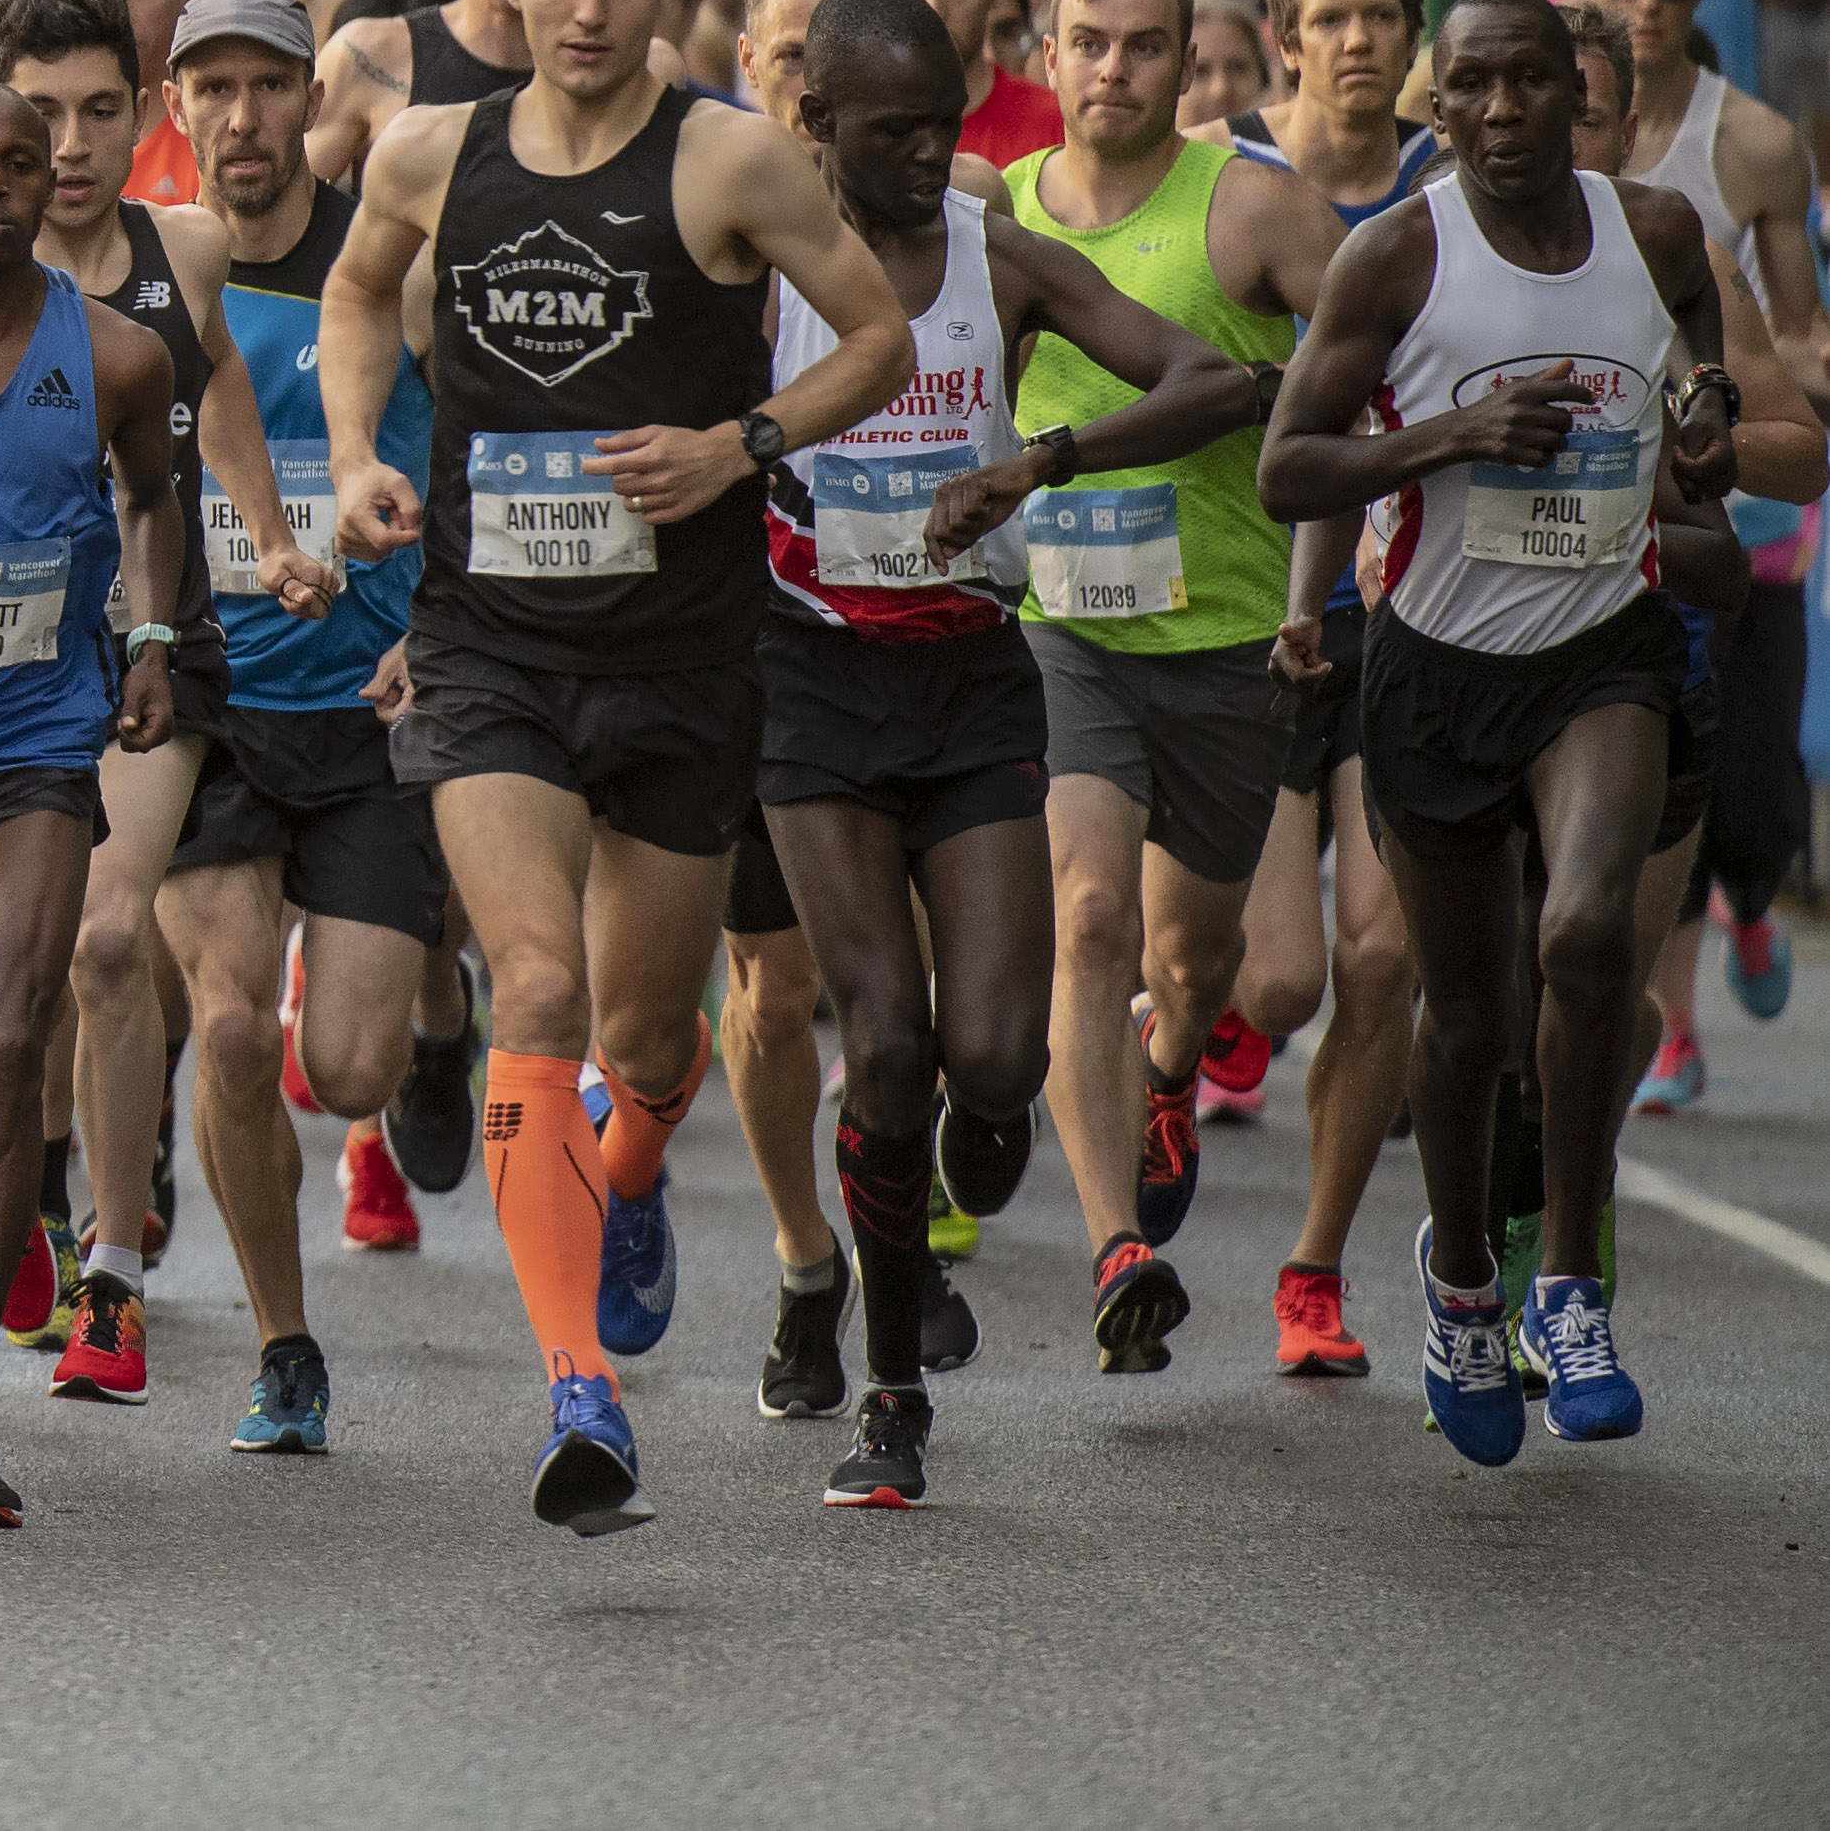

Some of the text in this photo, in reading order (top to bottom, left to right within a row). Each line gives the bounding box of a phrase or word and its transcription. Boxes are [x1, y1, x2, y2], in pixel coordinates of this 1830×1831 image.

[486, 288, 607, 327] M2M
[513, 335, 586, 353] RUNNING
[27, 391, 80, 411] adidas
[919, 428, 970, 443] CLUB
[281, 459, 329, 469] Vancouv
[506, 500, 611, 531] ANTHONY
[1531, 497, 1587, 525] PAUL
[523, 538, 590, 567] 10010
[1520, 530, 1587, 559] 10004
[8, 557, 61, 571] Vancouver
[8, 568, 56, 582] Marathon
[1079, 584, 1137, 609] 12039
